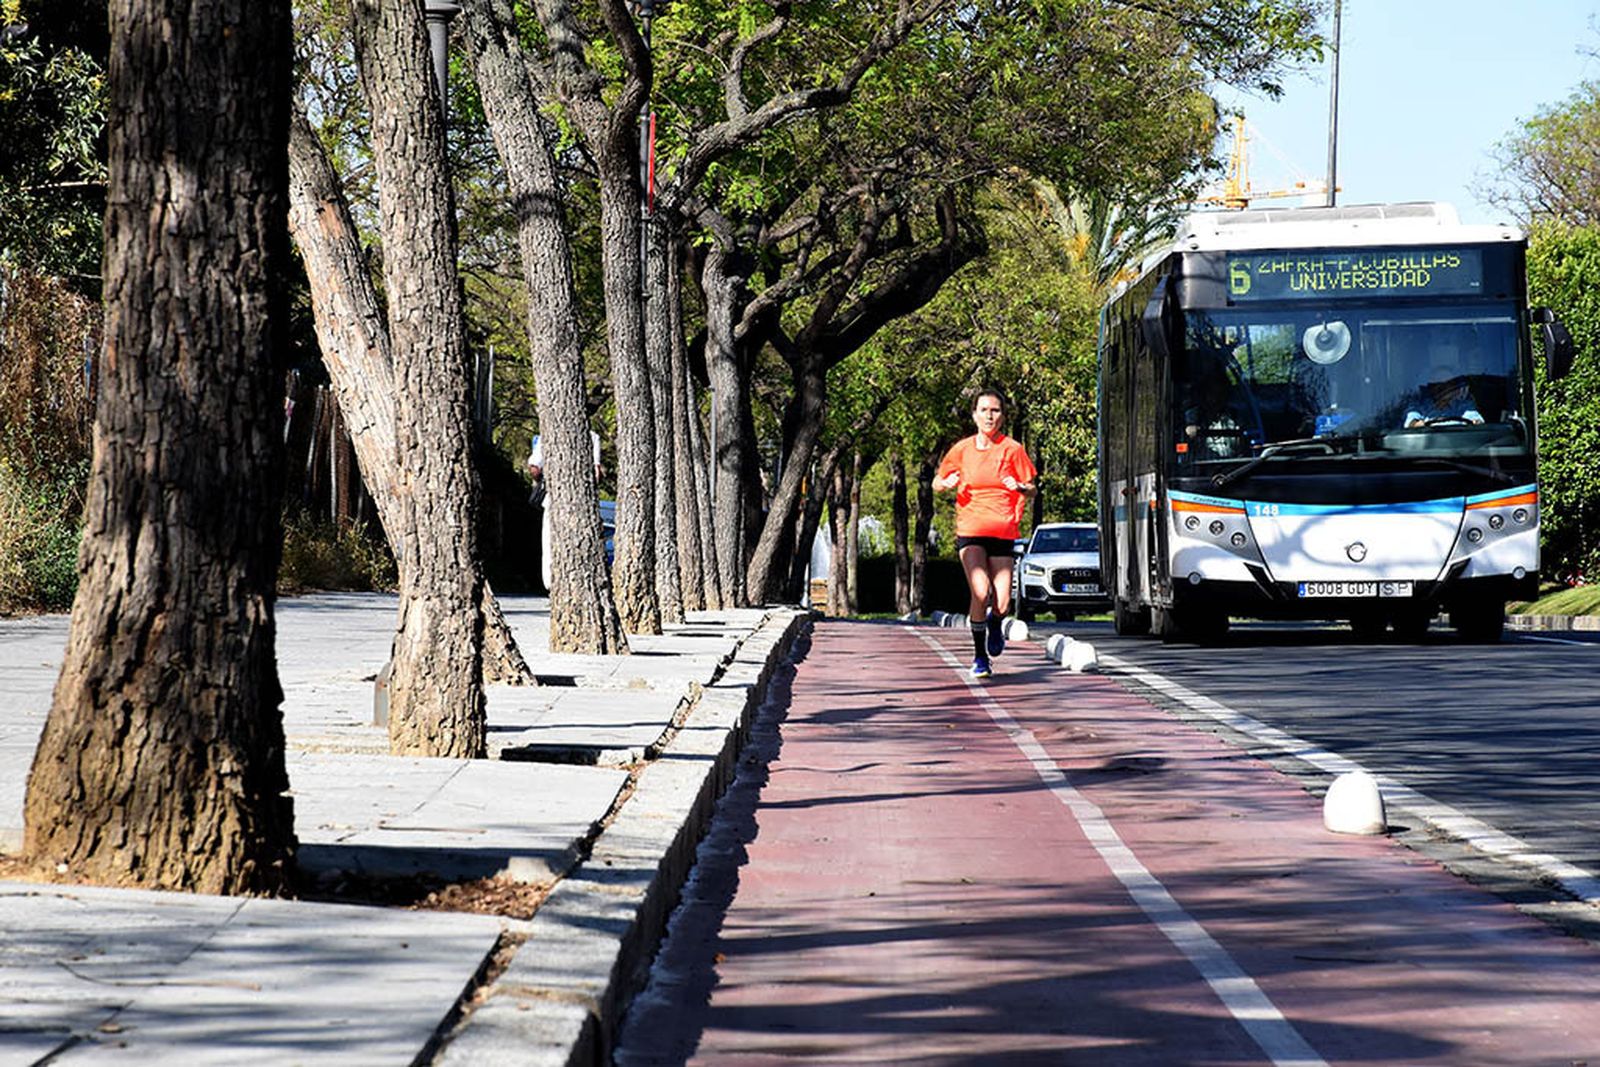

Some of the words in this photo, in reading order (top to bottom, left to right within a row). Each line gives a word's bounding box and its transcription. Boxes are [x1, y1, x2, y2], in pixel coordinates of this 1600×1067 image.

[1228, 258, 1251, 295] 6
[1290, 269, 1431, 291] UNIVERSIDAD
[1254, 505, 1280, 516] 148
[1307, 582, 1343, 595] 6008
